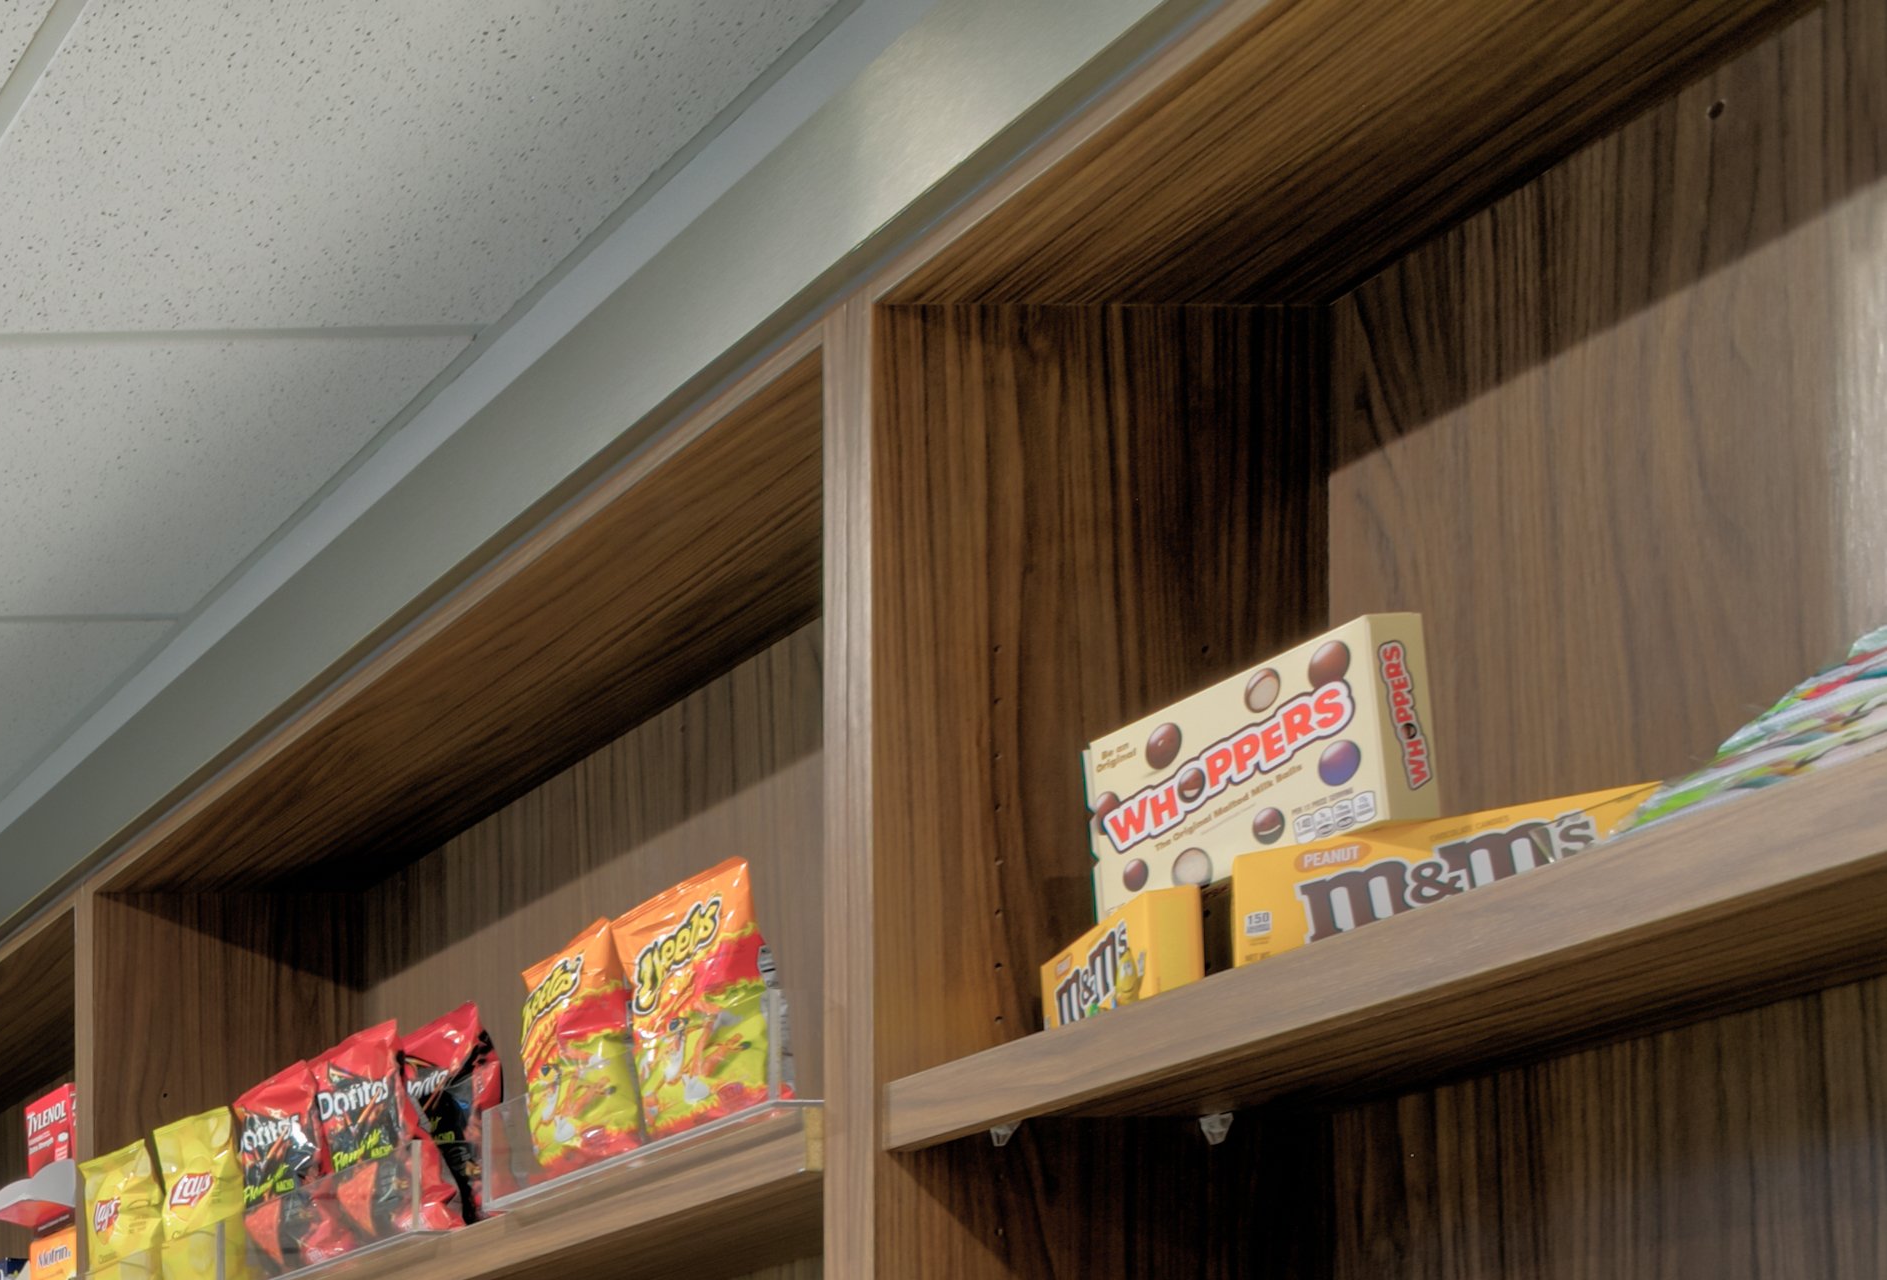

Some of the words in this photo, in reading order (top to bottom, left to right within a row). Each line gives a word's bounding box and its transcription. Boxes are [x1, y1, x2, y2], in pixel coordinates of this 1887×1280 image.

[1382, 644, 1429, 786] WHOPPERS
[1109, 689, 1344, 843] WHOPPERS
[1303, 847, 1360, 868] PEANUT
[1246, 913, 1269, 926] 150
[318, 1078, 389, 1120] Doritos
[27, 1101, 67, 1137] TYLENOL
